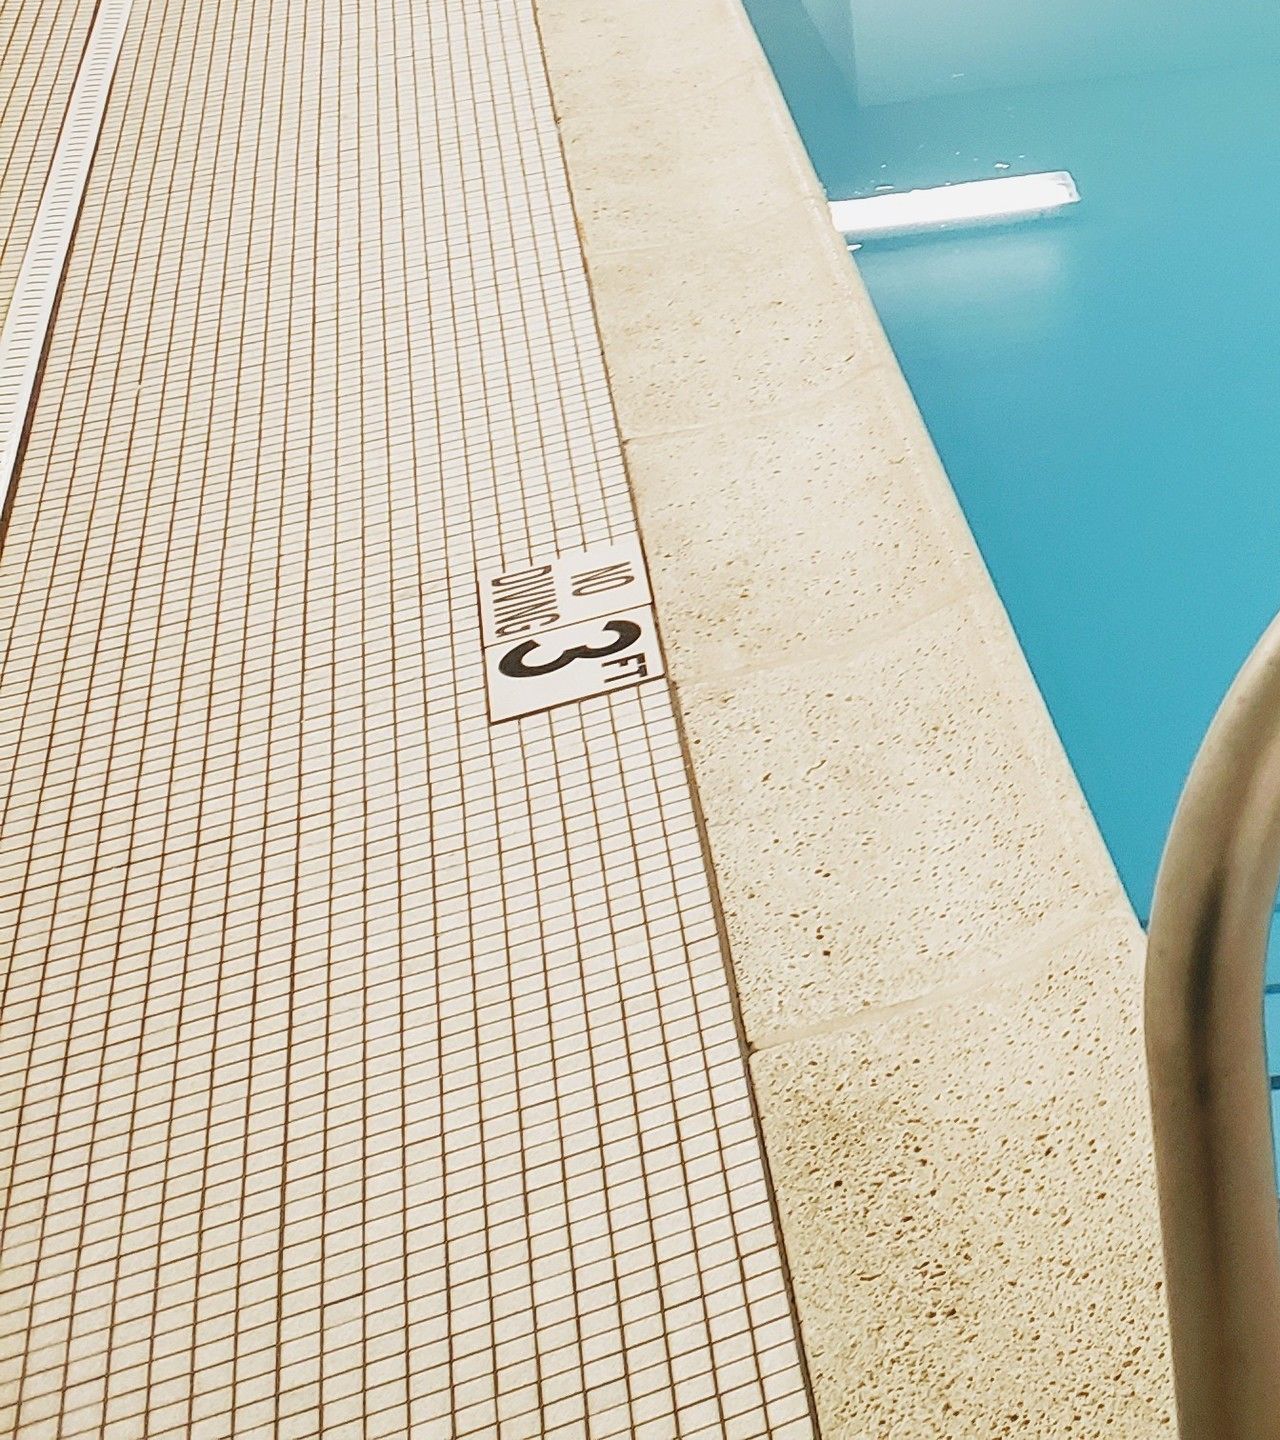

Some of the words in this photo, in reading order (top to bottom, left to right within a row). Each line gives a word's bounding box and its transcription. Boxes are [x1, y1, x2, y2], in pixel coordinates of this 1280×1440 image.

[491, 564, 560, 638] DIVING
[571, 561, 635, 596] NO
[498, 620, 642, 678] 3
[601, 652, 648, 684] FT
